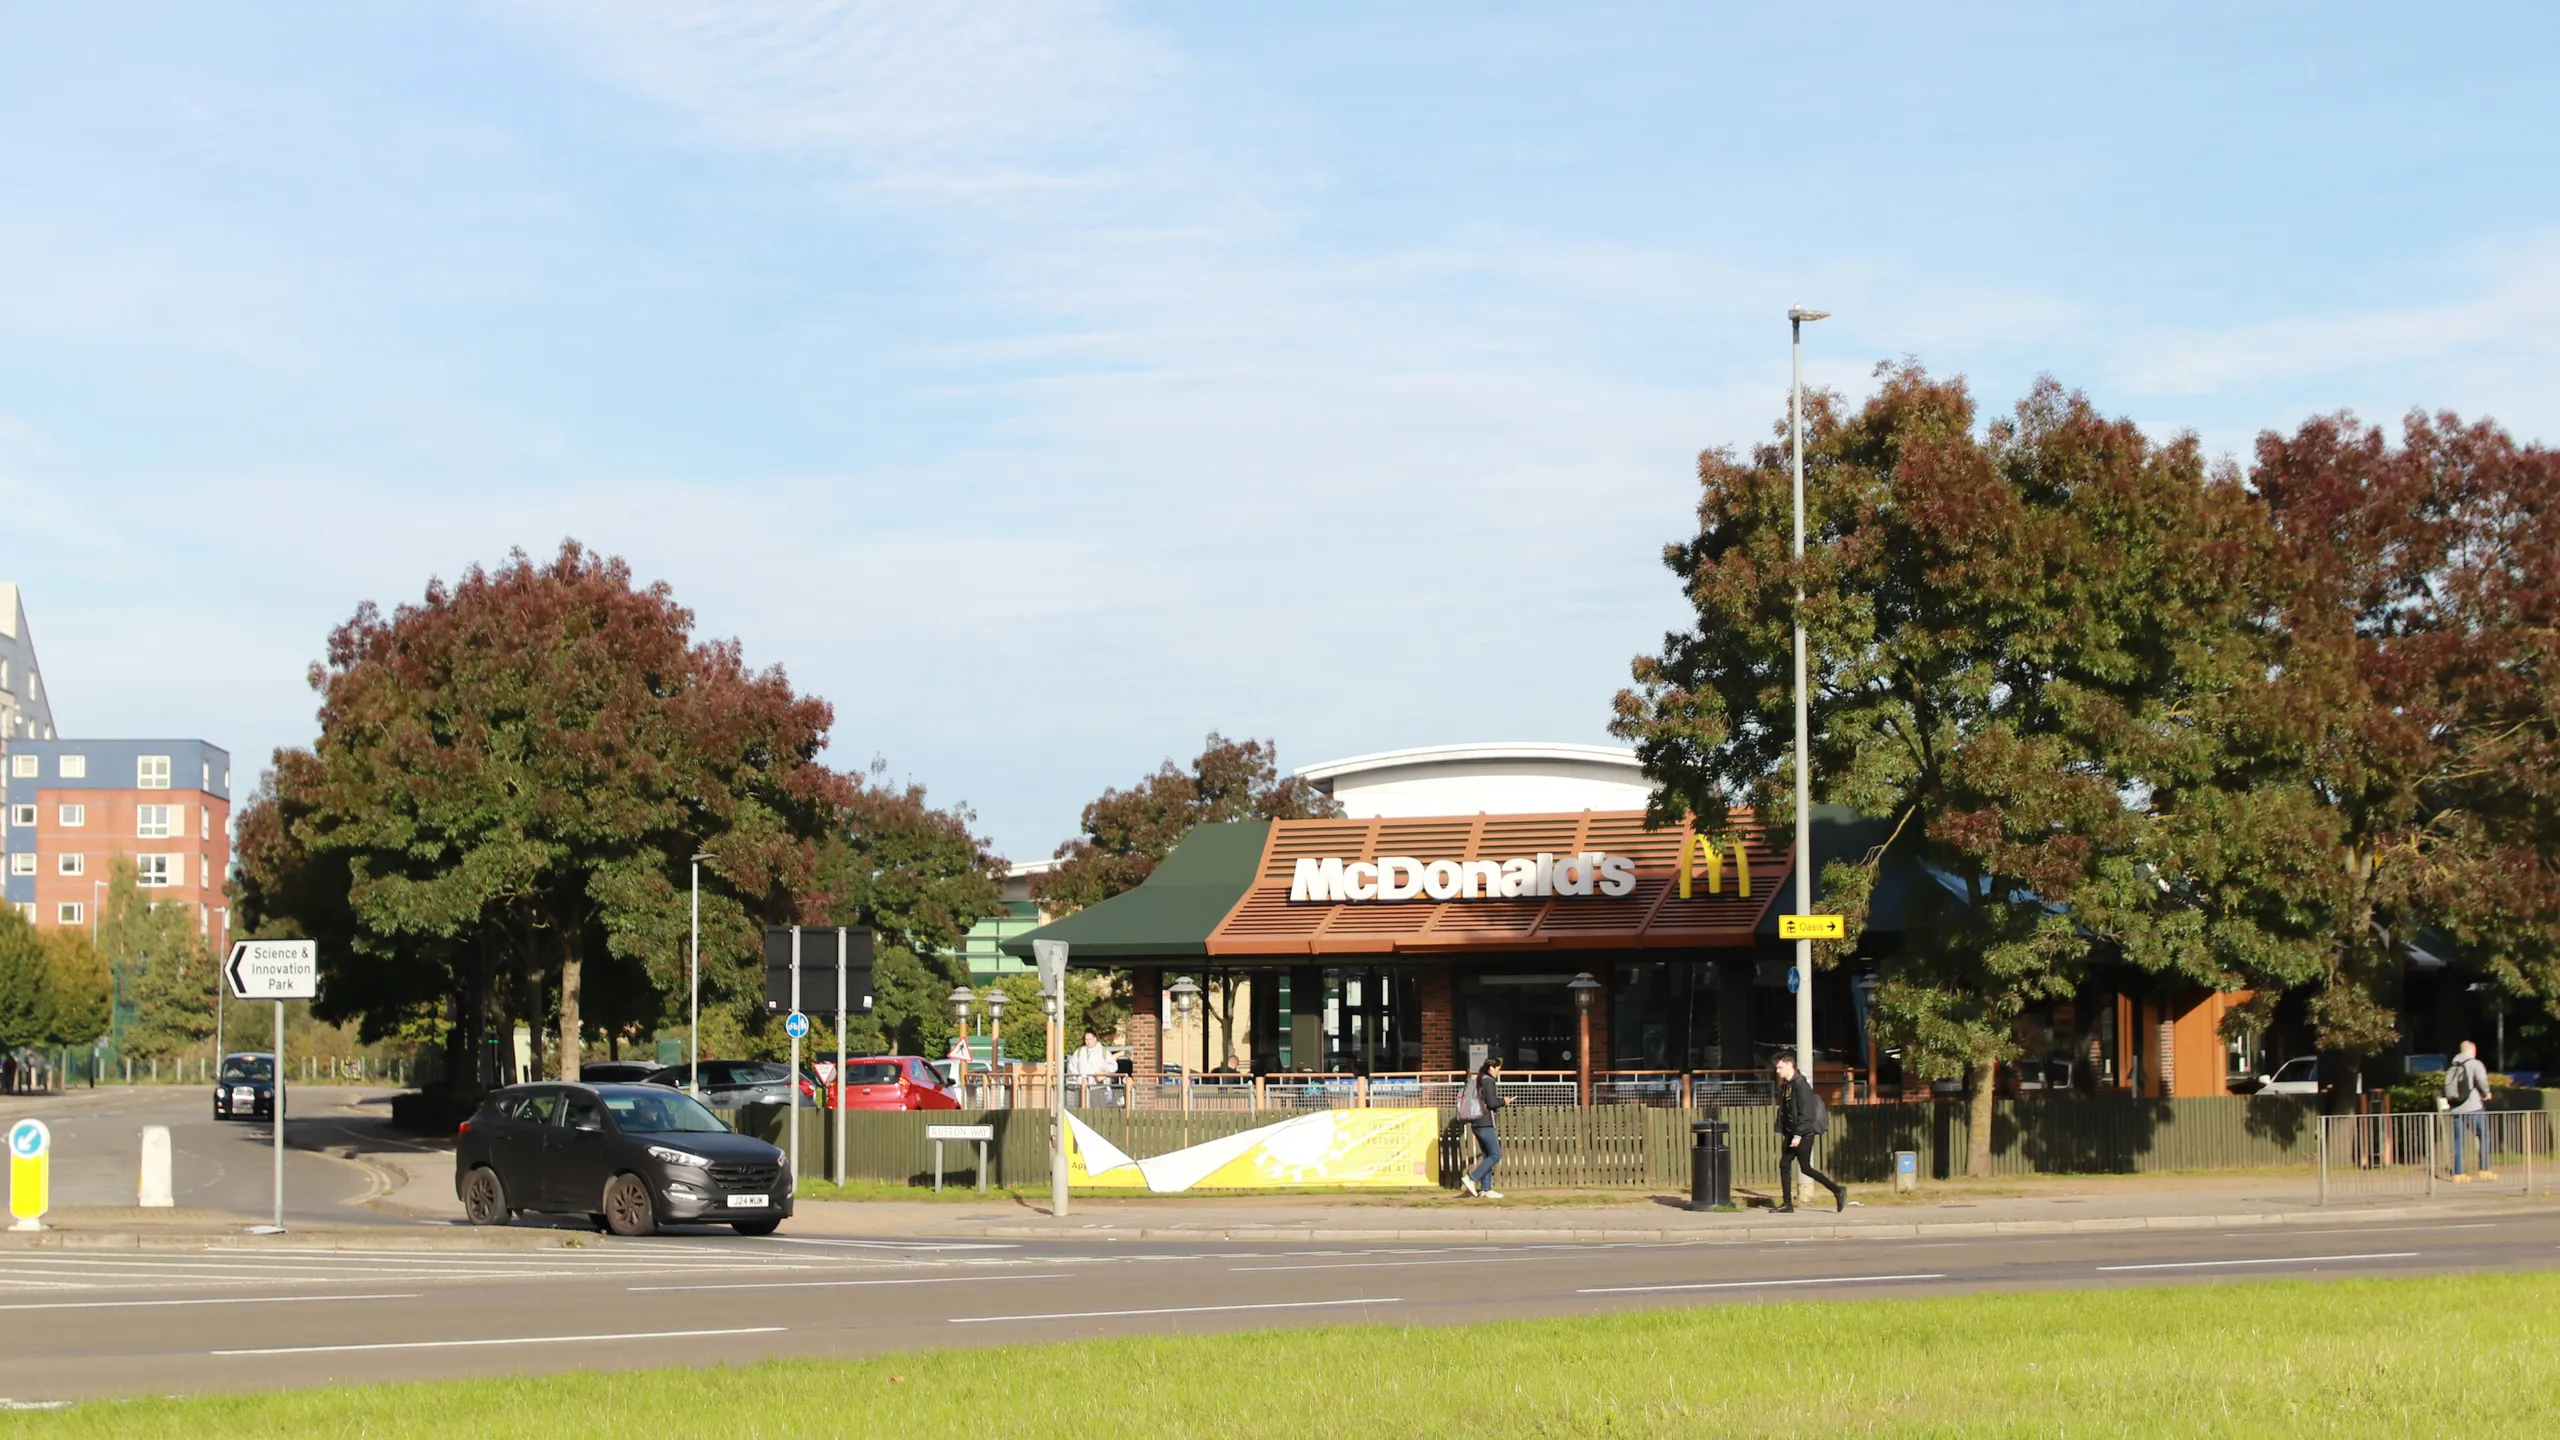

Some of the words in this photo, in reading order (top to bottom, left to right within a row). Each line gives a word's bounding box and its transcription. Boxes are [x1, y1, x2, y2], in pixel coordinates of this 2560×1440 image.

[1290, 852, 1636, 900] McDonald's
[1799, 922, 1824, 931] Oasis
[254, 947, 297, 959] Science
[301, 947, 308, 958] &
[252, 963, 311, 975] Innovation
[269, 979, 294, 990] Park
[931, 1127, 967, 1136] RUSTON
[971, 1127, 988, 1136] WAY
[1396, 1164, 1406, 1173] AT
